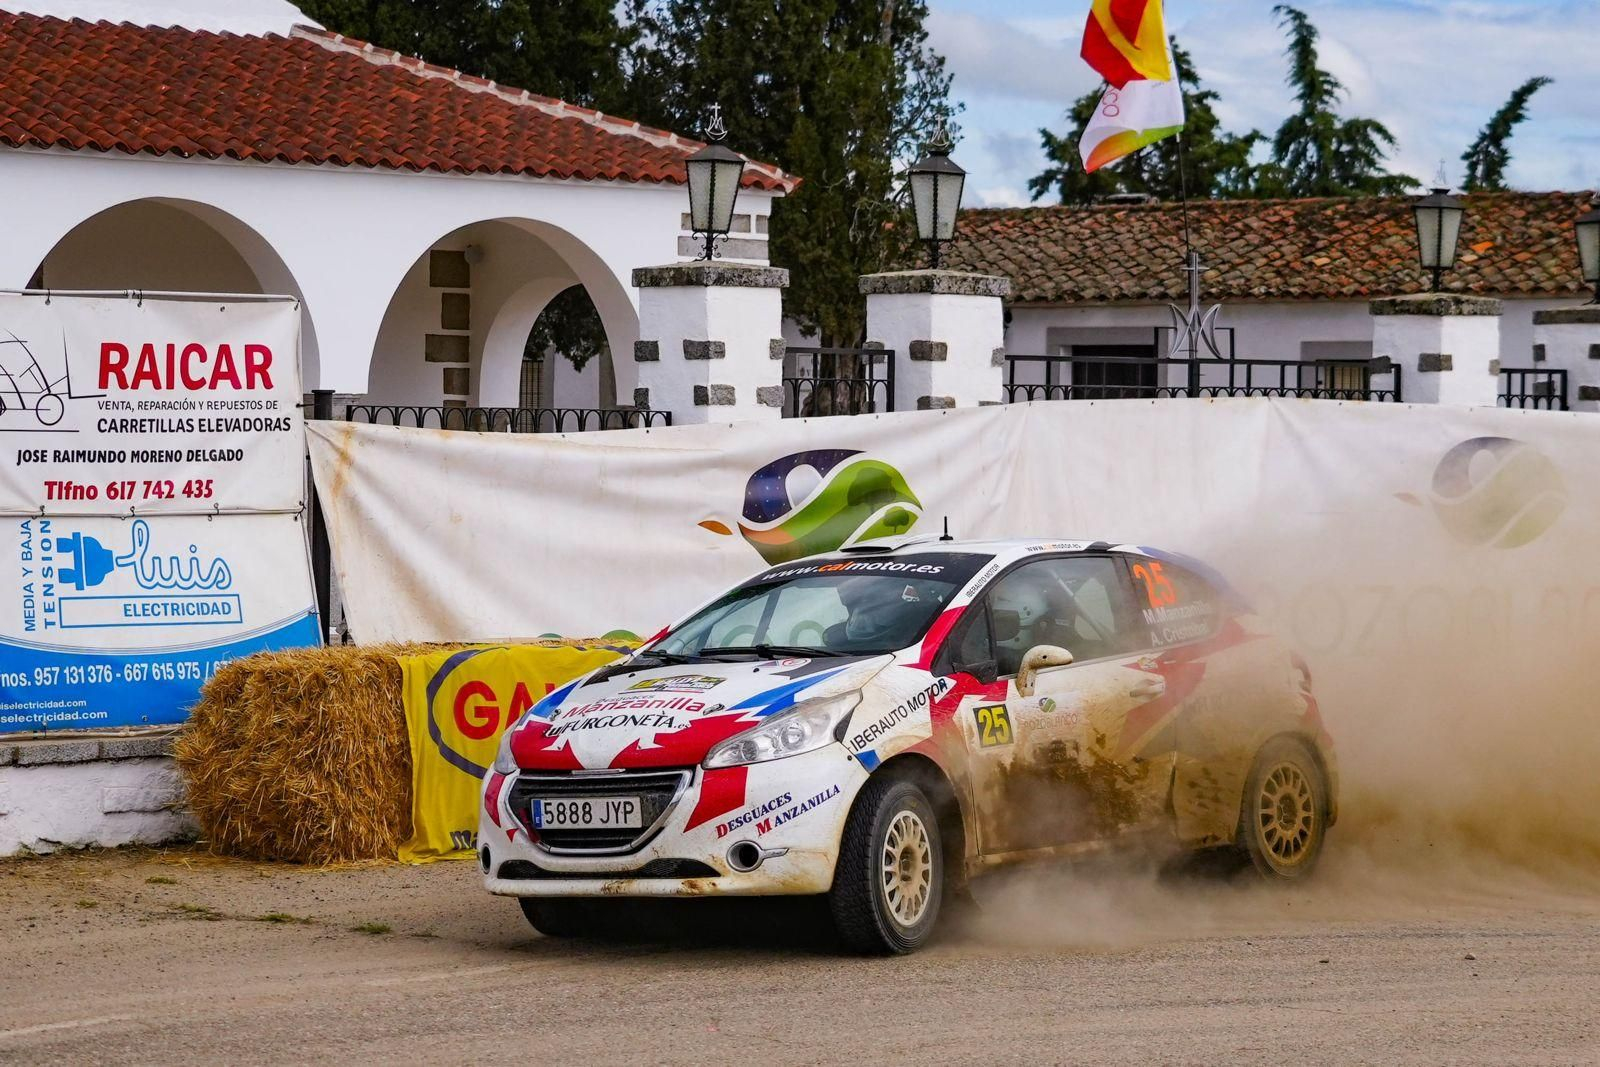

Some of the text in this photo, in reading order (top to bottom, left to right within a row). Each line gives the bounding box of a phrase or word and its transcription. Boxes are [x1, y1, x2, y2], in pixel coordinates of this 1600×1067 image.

[98, 342, 274, 391] RAICAR
[97, 397, 279, 412] VENTA, REPARACIÓN Y REPUESTOS DE
[97, 417, 292, 434] CARRETILLAS ELEVADORAS
[16, 448, 244, 466] JOSE RAIMUNDO MORENO DELGADO
[44, 479, 214, 501] Tlfno 617 742 435
[20, 519, 36, 632] MEDIA Y BAJA
[39, 520, 56, 629] TENSION
[761, 560, 945, 582] www.calmotor.es
[1132, 562, 1176, 608] 25
[123, 601, 232, 618] ELECTRICIDAD
[34, 666, 60, 686] 957
[64, 667, 85, 685] 131
[88, 666, 113, 684] 376
[124, 663, 149, 682] 667
[152, 663, 175, 681] 615
[178, 661, 200, 680] 975
[453, 680, 555, 740] GA
[562, 697, 706, 719] Manzanilla
[850, 677, 949, 753] IBERAUTO MOTOR
[977, 706, 1010, 746] 25
[544, 801, 593, 825] 5888
[600, 801, 635, 825] JYP
[715, 791, 793, 839] DESGUACES
